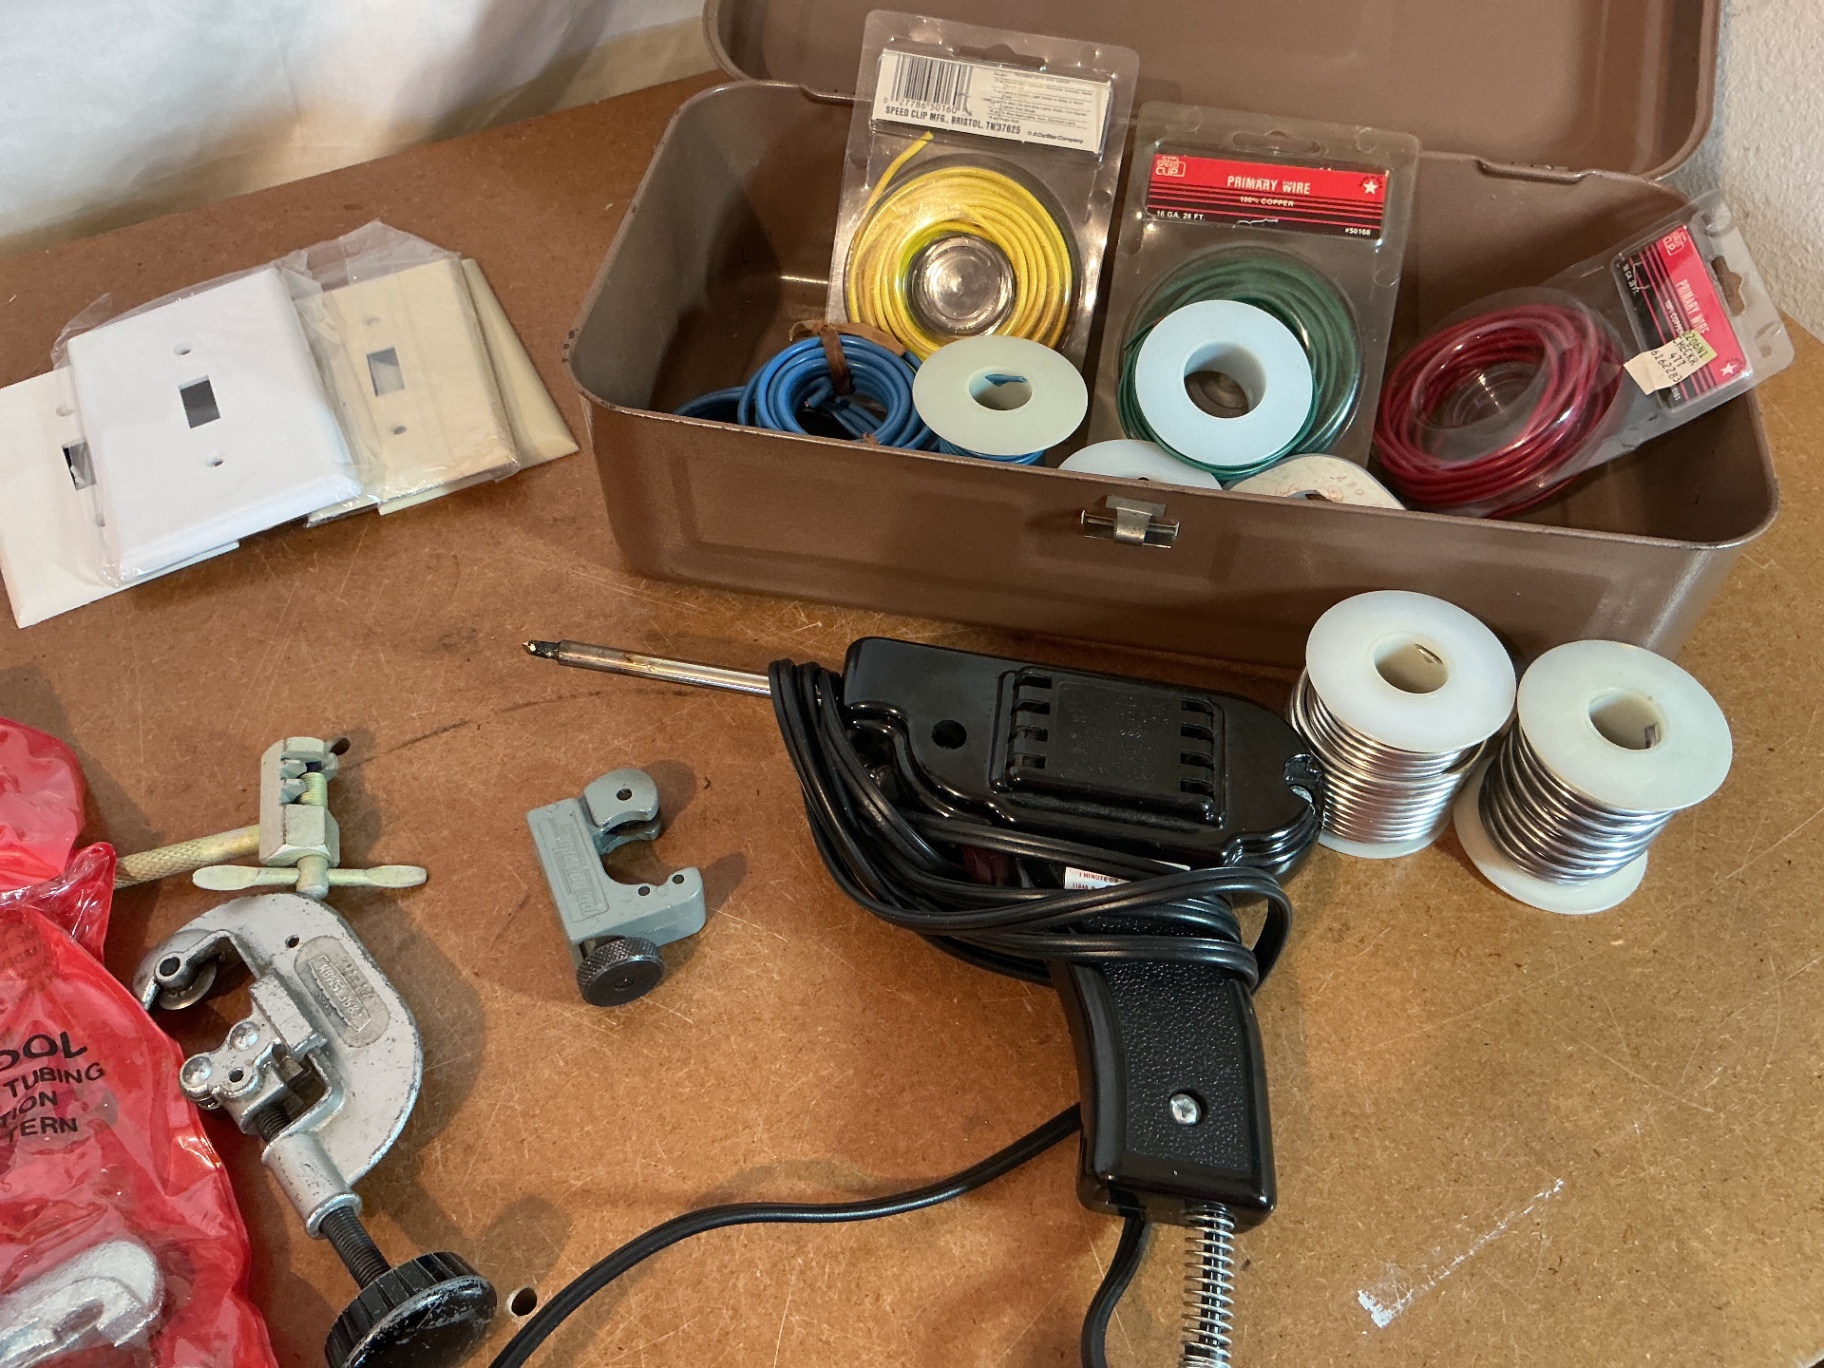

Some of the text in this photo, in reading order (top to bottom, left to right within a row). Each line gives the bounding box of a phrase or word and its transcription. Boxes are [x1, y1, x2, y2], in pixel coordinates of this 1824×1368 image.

[899, 100, 926, 109] 27786
[885, 106, 909, 117] SPEED
[911, 109, 928, 120] CLIP
[1155, 167, 1179, 177] CLIP
[1227, 175, 1311, 195] PRIMARY WIRE
[1240, 196, 1294, 207] 100% COPPER
[1676, 279, 1709, 334] PRIMARY WIRE
[1083, 873, 1109, 883] MINUTE
[2, 1062, 105, 1098] TUBING
